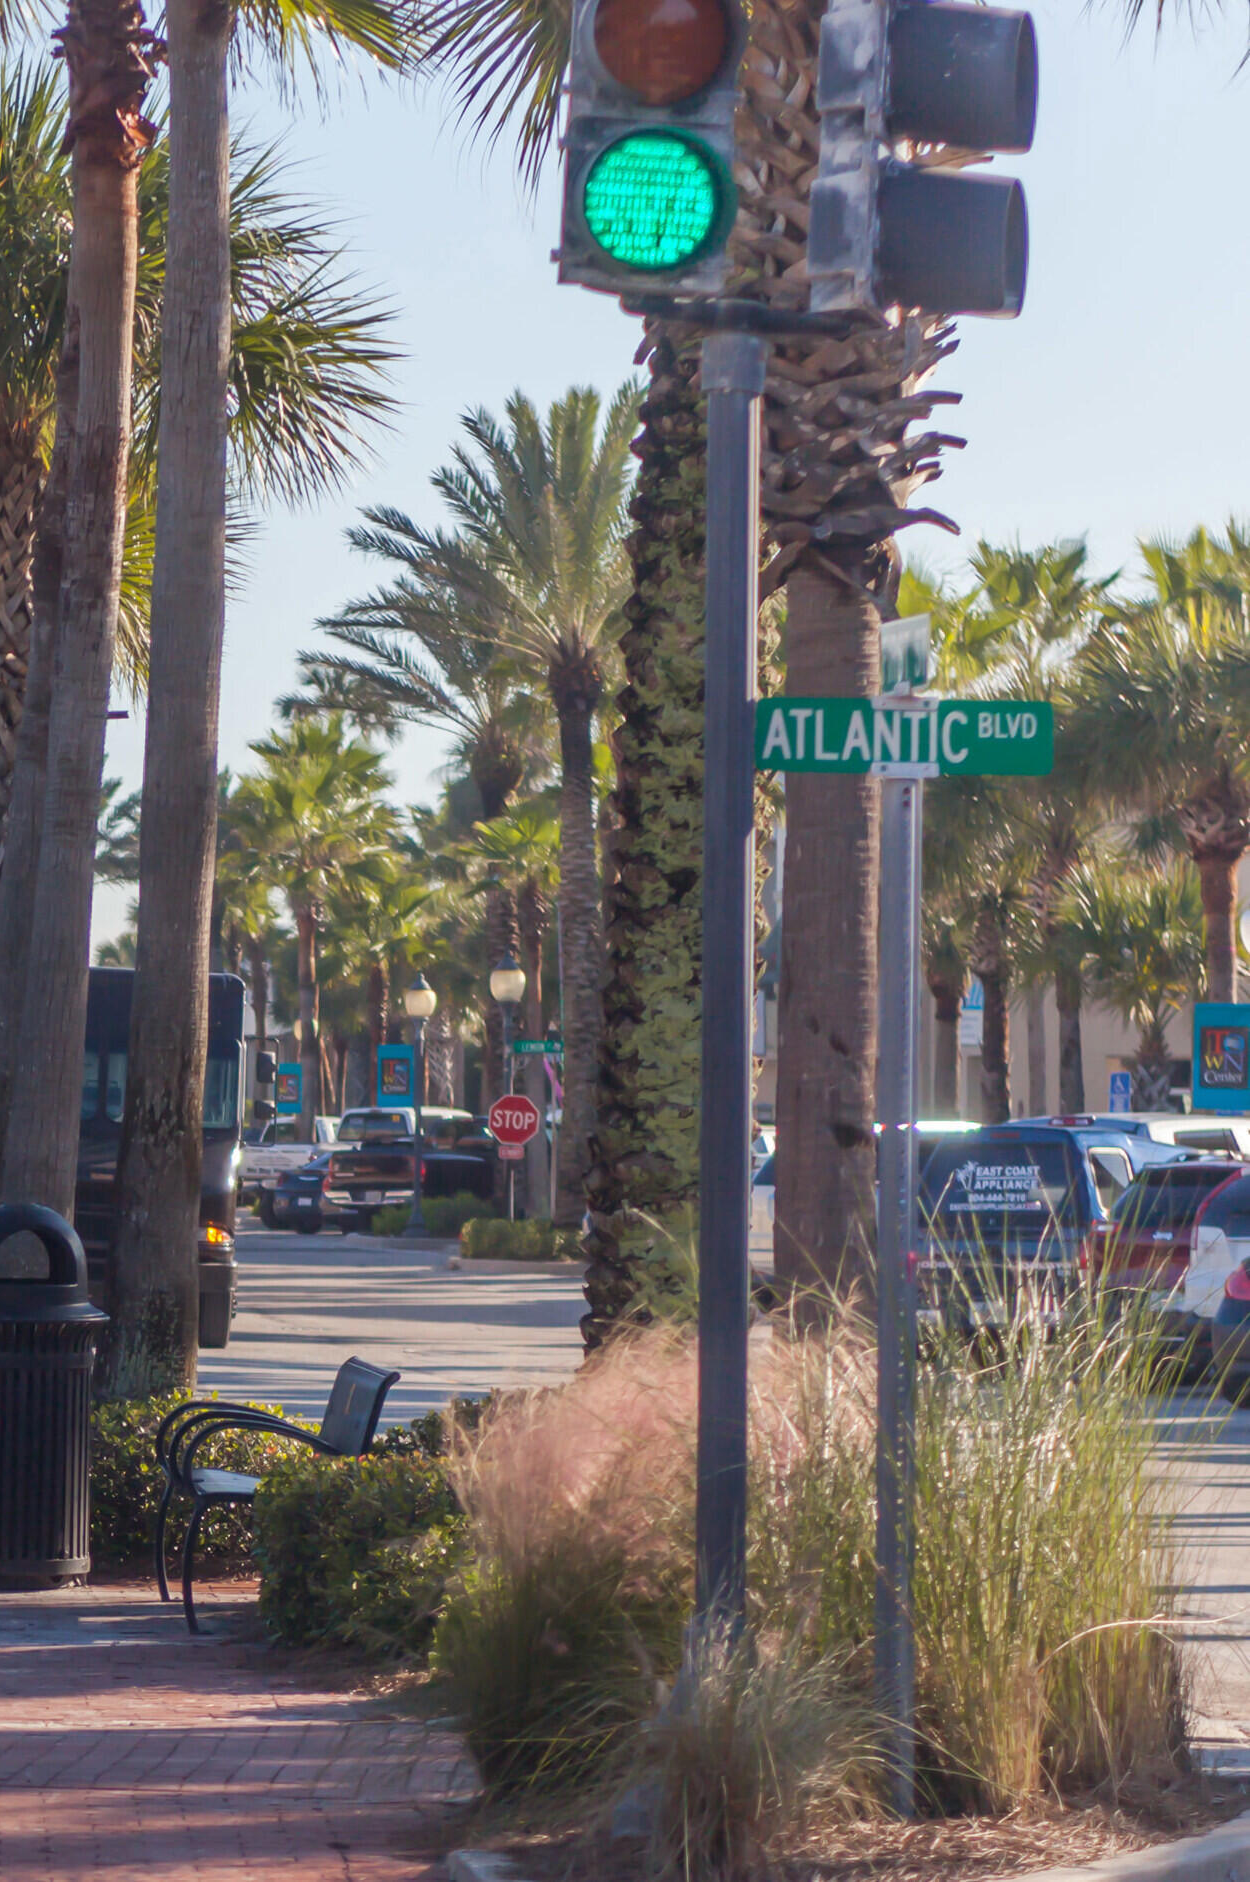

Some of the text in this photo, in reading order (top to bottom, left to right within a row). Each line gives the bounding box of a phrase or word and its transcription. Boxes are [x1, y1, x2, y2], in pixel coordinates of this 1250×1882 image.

[762, 708, 1038, 763] ATLANTIC BLVD
[492, 1110, 535, 1130] STOP
[976, 1166, 1040, 1176] EAST COAST
[973, 1180, 1039, 1190] APPLIANCE
